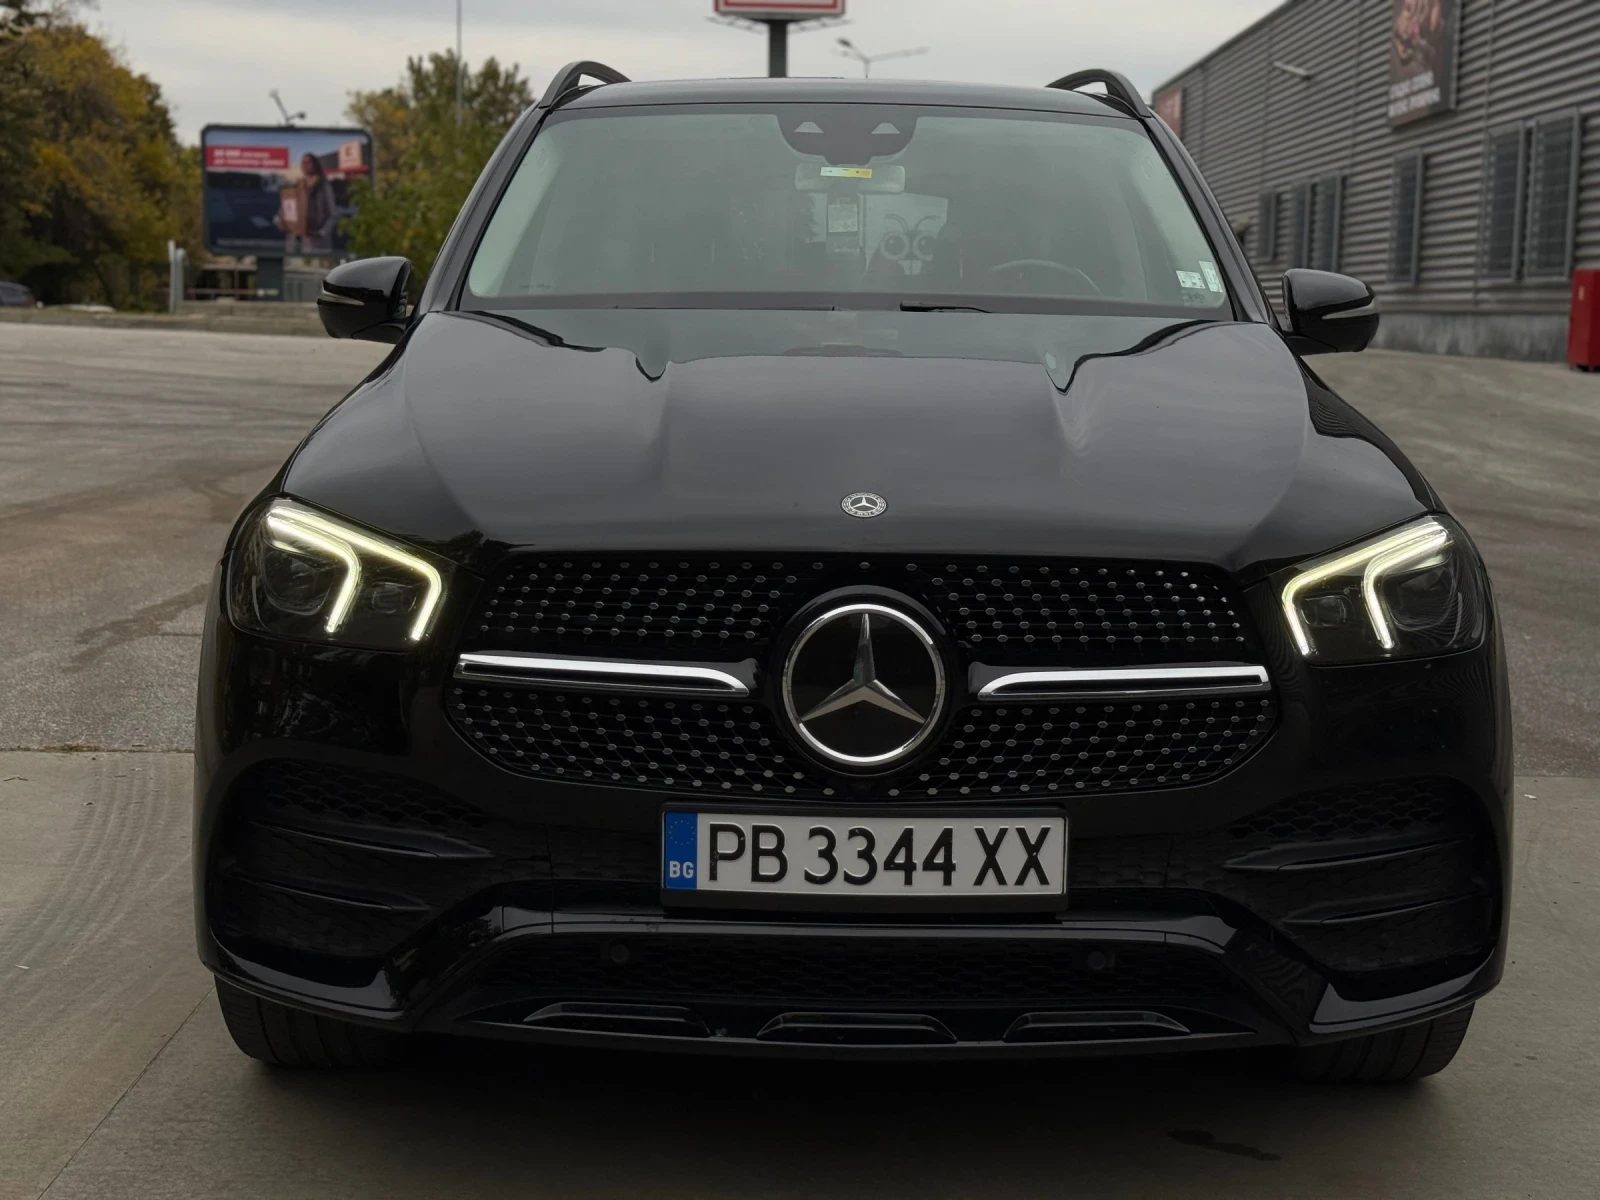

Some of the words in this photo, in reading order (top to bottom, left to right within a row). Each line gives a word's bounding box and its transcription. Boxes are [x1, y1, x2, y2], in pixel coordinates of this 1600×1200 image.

[669, 861, 694, 878] BG
[709, 822, 788, 882] PB
[804, 825, 956, 885] 3344
[973, 825, 1051, 886] XX
